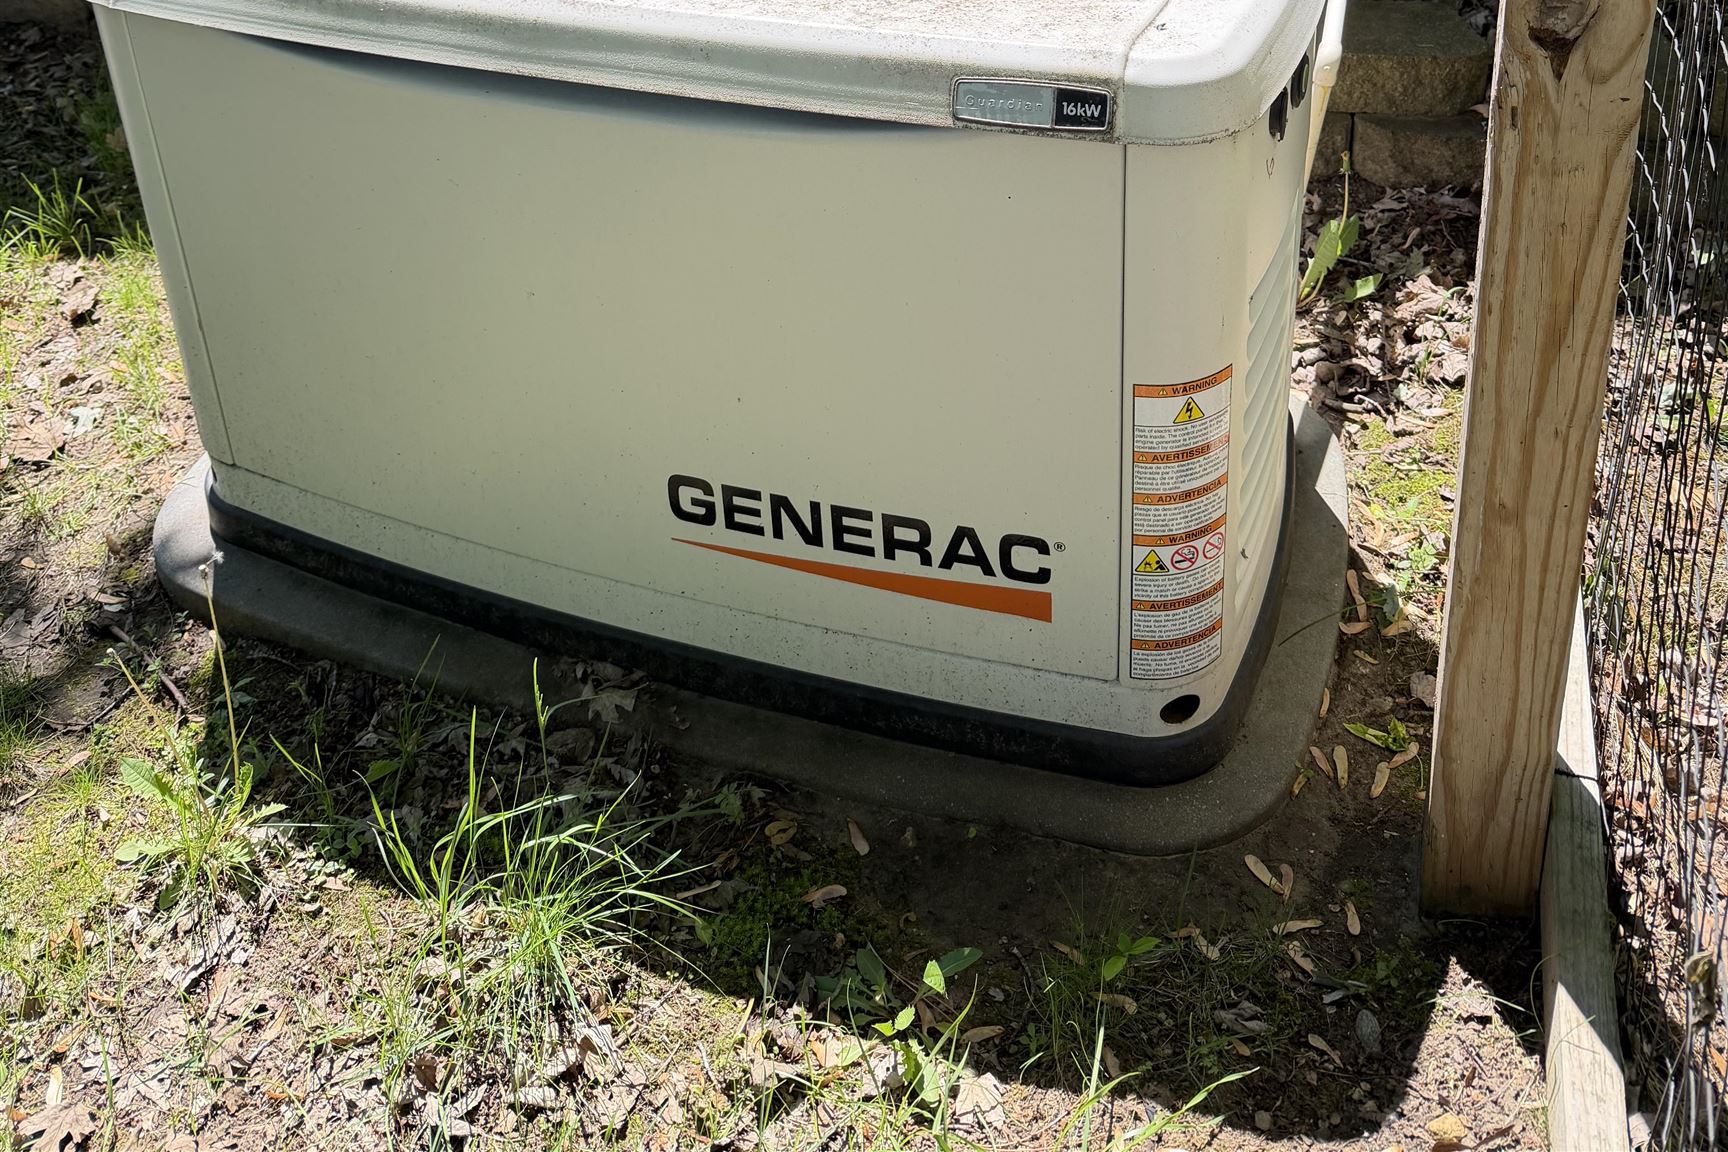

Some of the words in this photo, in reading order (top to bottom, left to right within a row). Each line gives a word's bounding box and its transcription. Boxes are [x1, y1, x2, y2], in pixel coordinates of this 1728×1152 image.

[965, 94, 1043, 112] Guardian
[1063, 101, 1102, 118] 16kW
[1172, 377, 1217, 394] WARNING
[1169, 441, 1191, 450] qualified
[1192, 435, 1208, 445] service
[1175, 469, 1201, 480] générateur
[1157, 479, 1221, 503] ADVERTENCIA
[667, 474, 1051, 584] GENERAC
[1169, 526, 1212, 544] WARNING
[1148, 583, 1221, 610] AVERTISSEMENT
[1154, 626, 1216, 649] ADVERTENCIA
